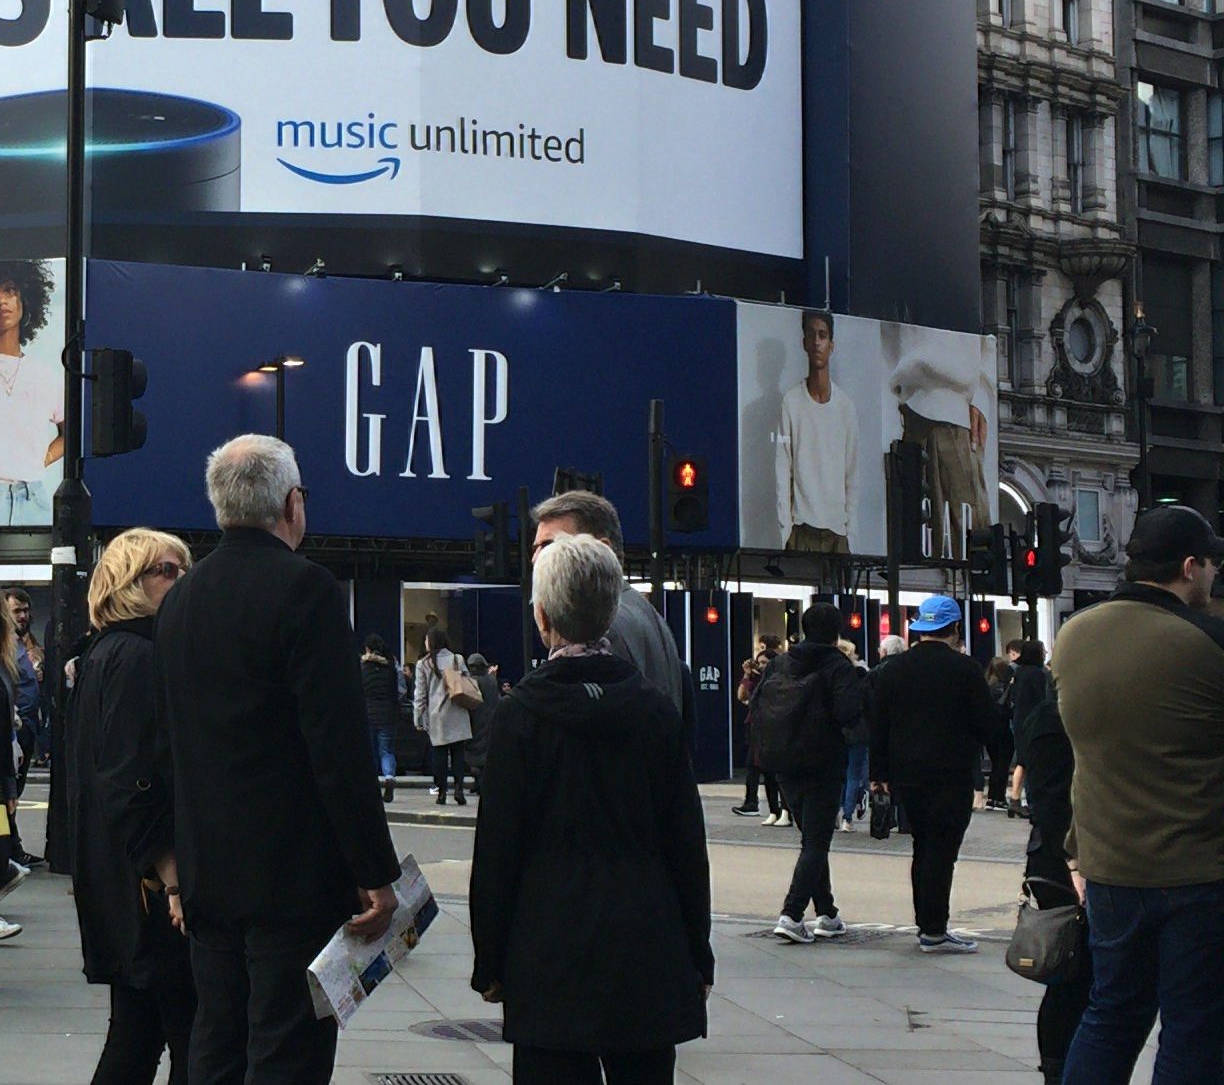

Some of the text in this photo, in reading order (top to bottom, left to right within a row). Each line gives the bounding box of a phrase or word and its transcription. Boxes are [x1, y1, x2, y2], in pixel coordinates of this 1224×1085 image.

[277, 113, 587, 165] music unlimited
[345, 341, 509, 481] GAP
[920, 497, 973, 561] GAP
[699, 666, 721, 683] GAP
